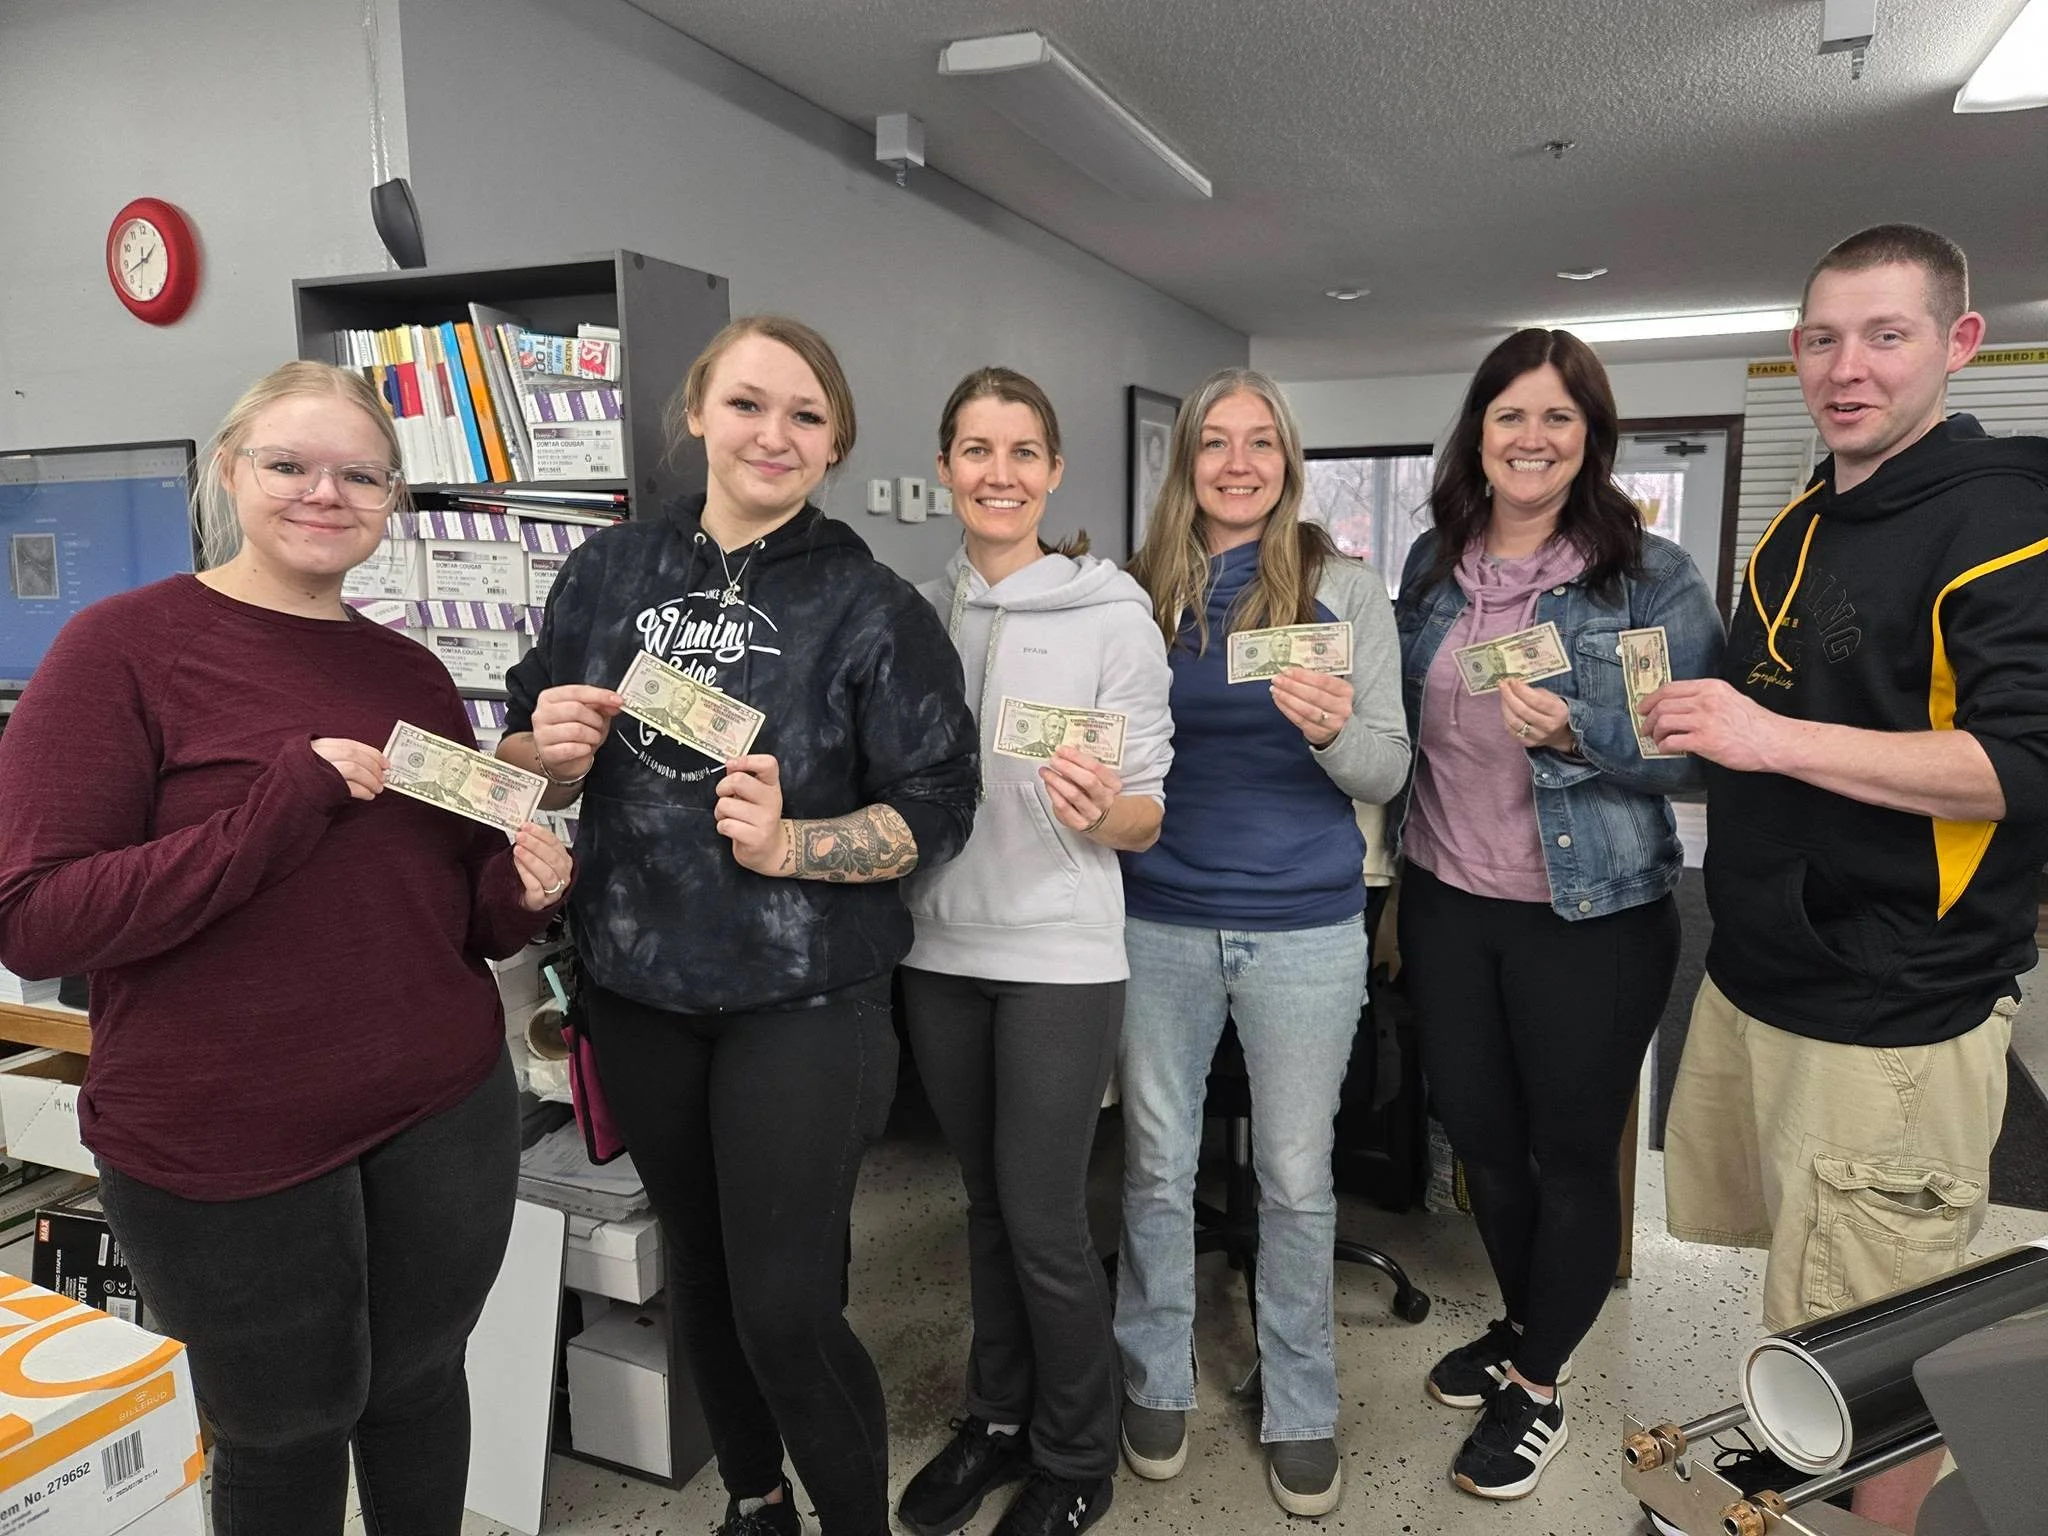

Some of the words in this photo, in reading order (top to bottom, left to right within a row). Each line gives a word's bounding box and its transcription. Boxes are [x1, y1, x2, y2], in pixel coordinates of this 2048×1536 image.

[130, 231, 137, 241] 11
[139, 225, 147, 236] 12
[123, 243, 132, 253] 10
[565, 340, 573, 372] SATIN
[1748, 364, 1786, 376] STAND
[536, 440, 560, 448] DOMTAR
[560, 440, 584, 448] COUGAR
[636, 606, 754, 664] Winning
[39, 1219, 50, 1242] MAX
[118, 1391, 168, 1422] BILLERUD
[24, 1491, 46, 1508] No.
[47, 1461, 91, 1496] 279652
